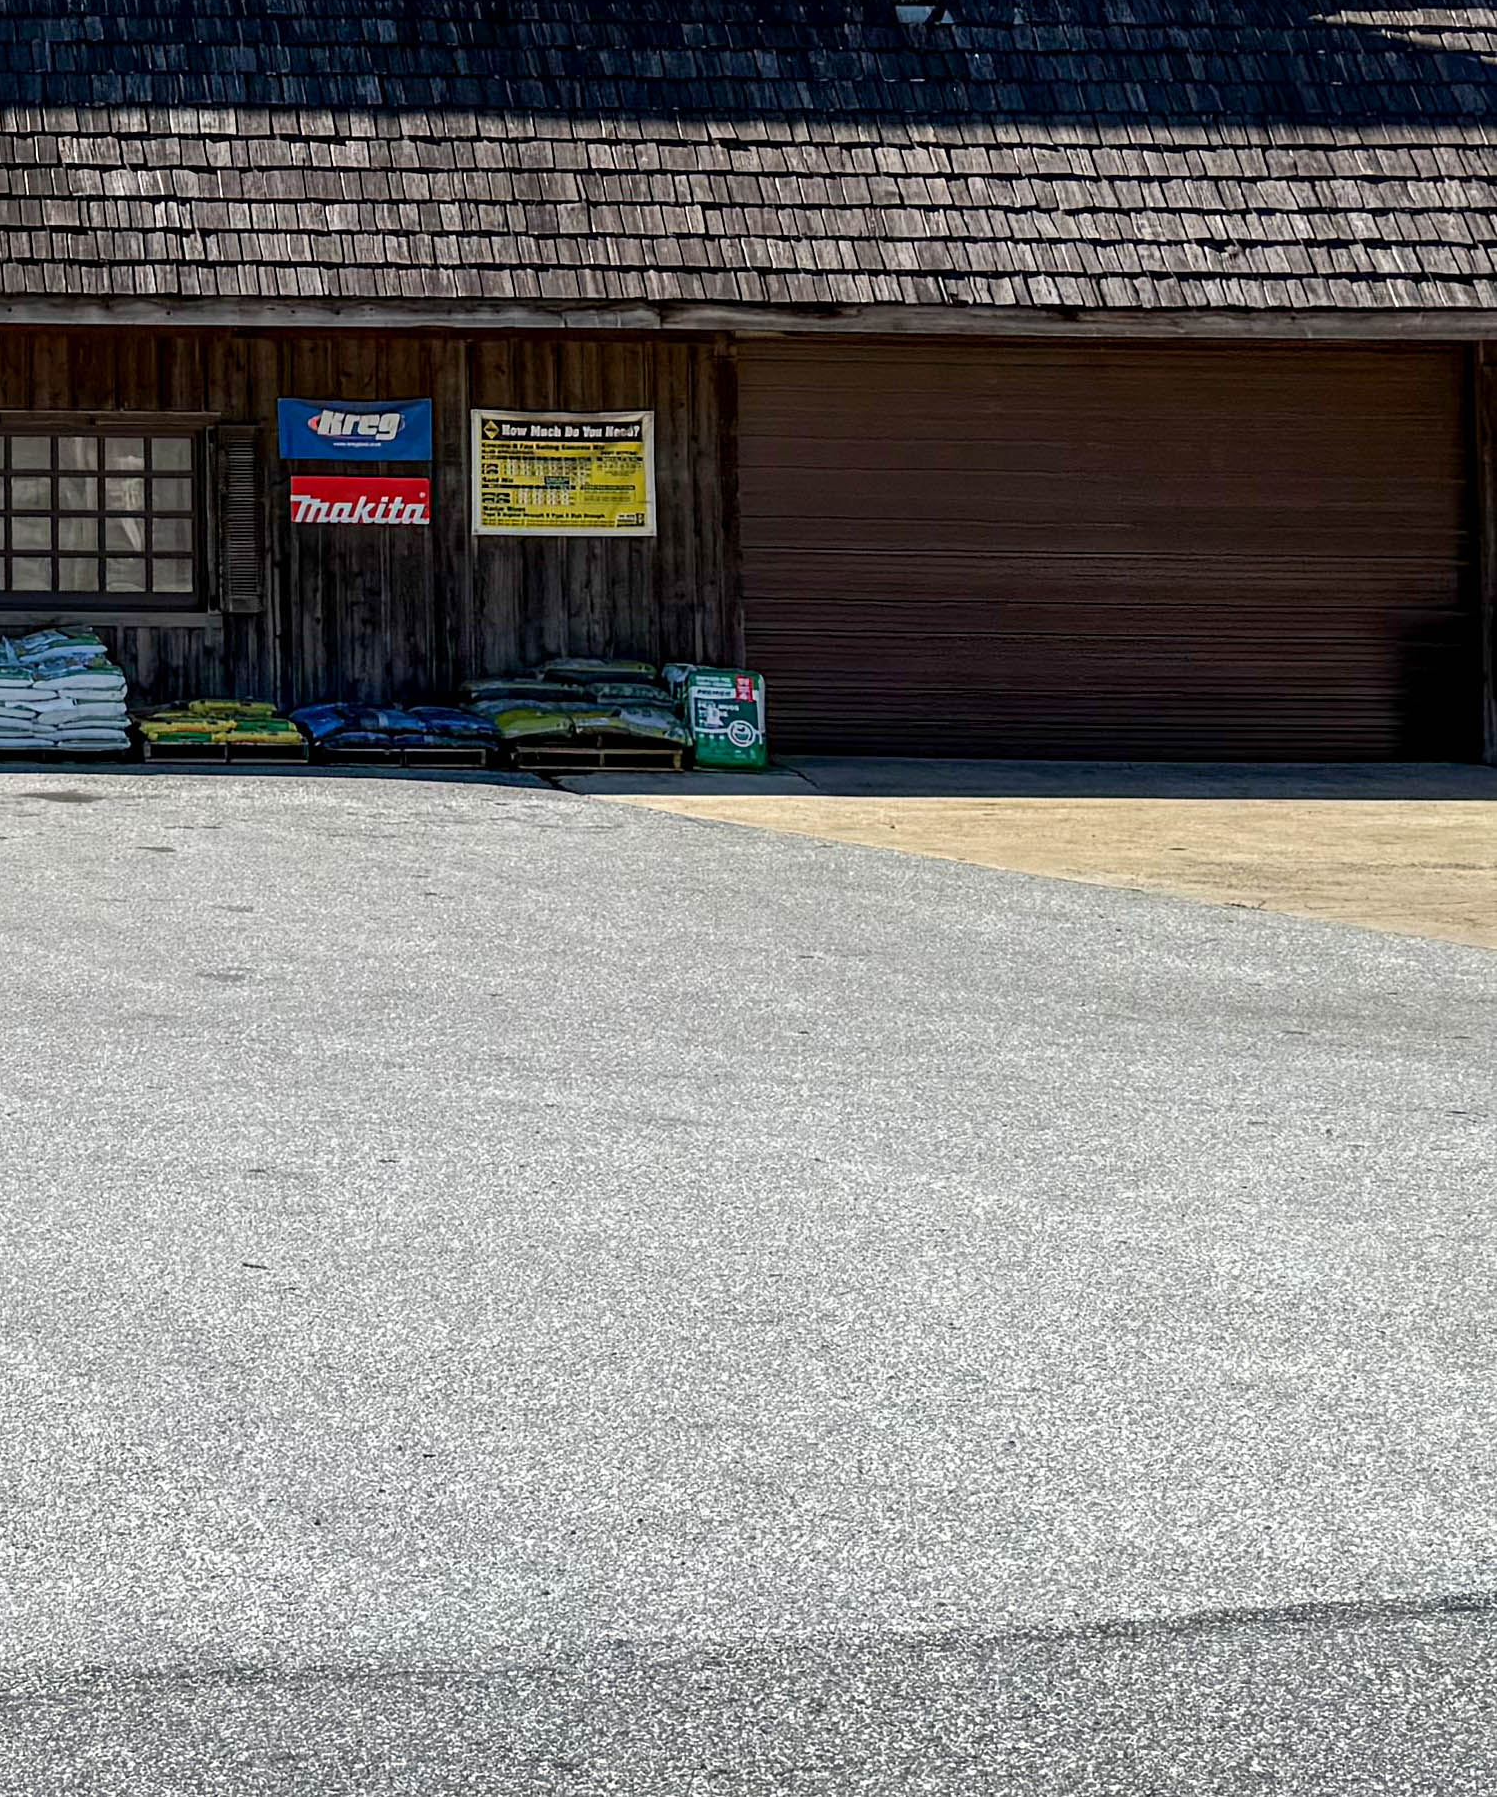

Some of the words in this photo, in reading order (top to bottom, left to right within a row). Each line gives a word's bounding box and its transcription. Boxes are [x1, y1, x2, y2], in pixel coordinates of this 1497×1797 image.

[316, 409, 401, 441] Kreg
[502, 424, 528, 437] How
[530, 425, 562, 438] Much
[564, 425, 580, 438] Do
[583, 425, 603, 438] You
